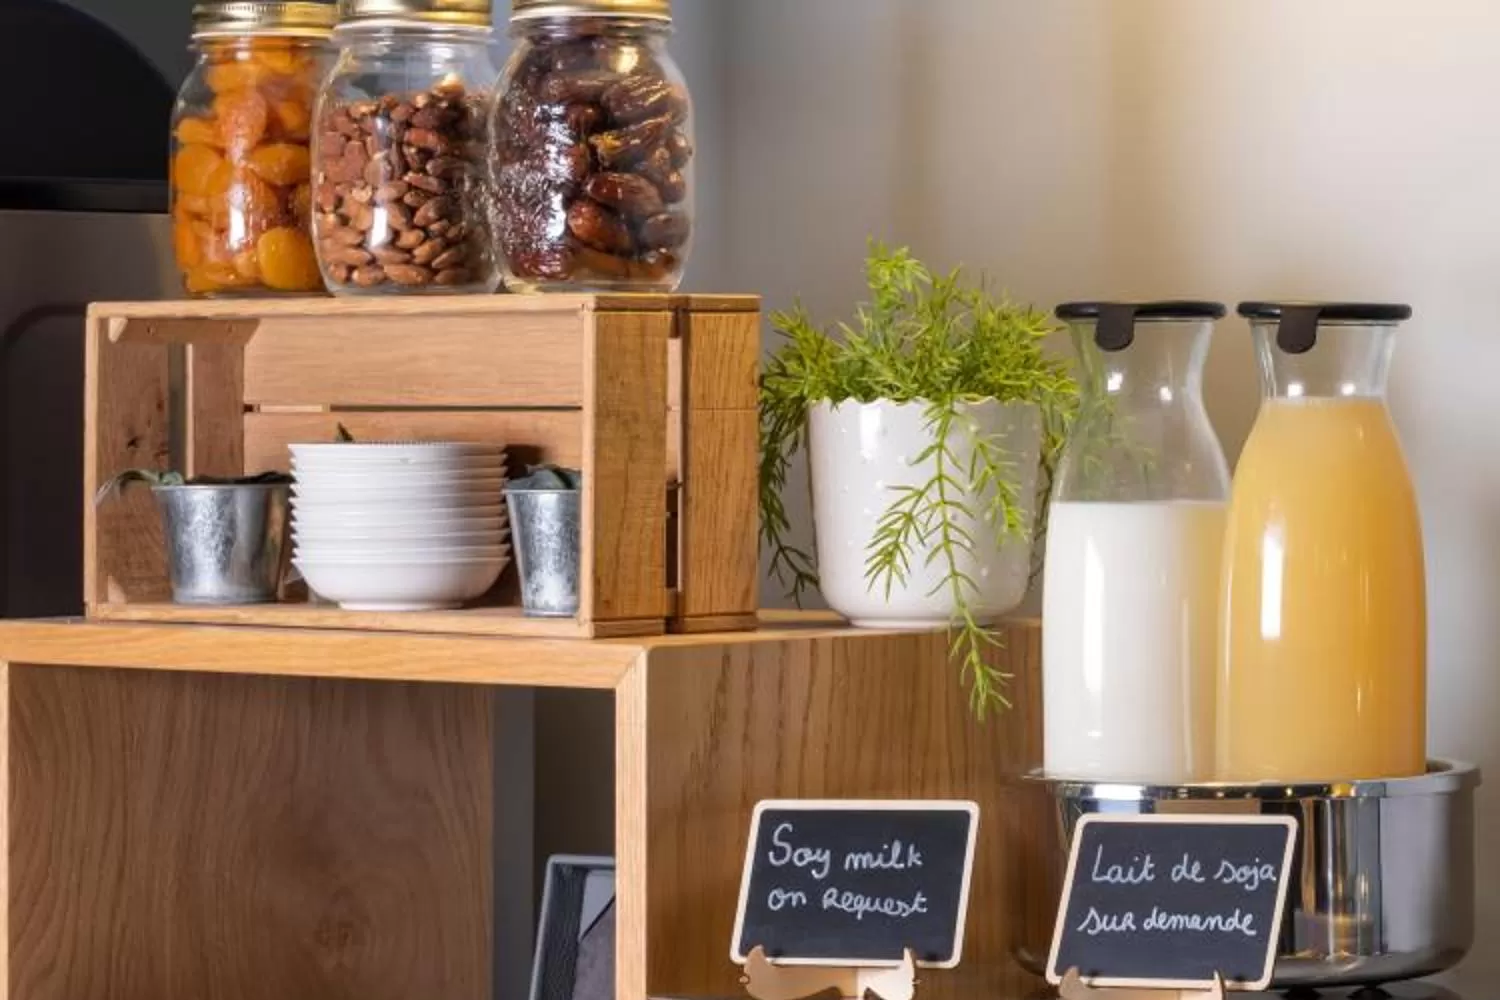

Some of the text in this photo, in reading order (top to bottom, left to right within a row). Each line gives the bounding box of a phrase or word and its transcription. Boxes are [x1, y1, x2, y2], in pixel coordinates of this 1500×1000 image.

[768, 822, 923, 879] Soy milk
[1091, 844, 1278, 891] Lait de soja
[767, 890, 808, 911] on
[1142, 905, 1257, 936] demande
